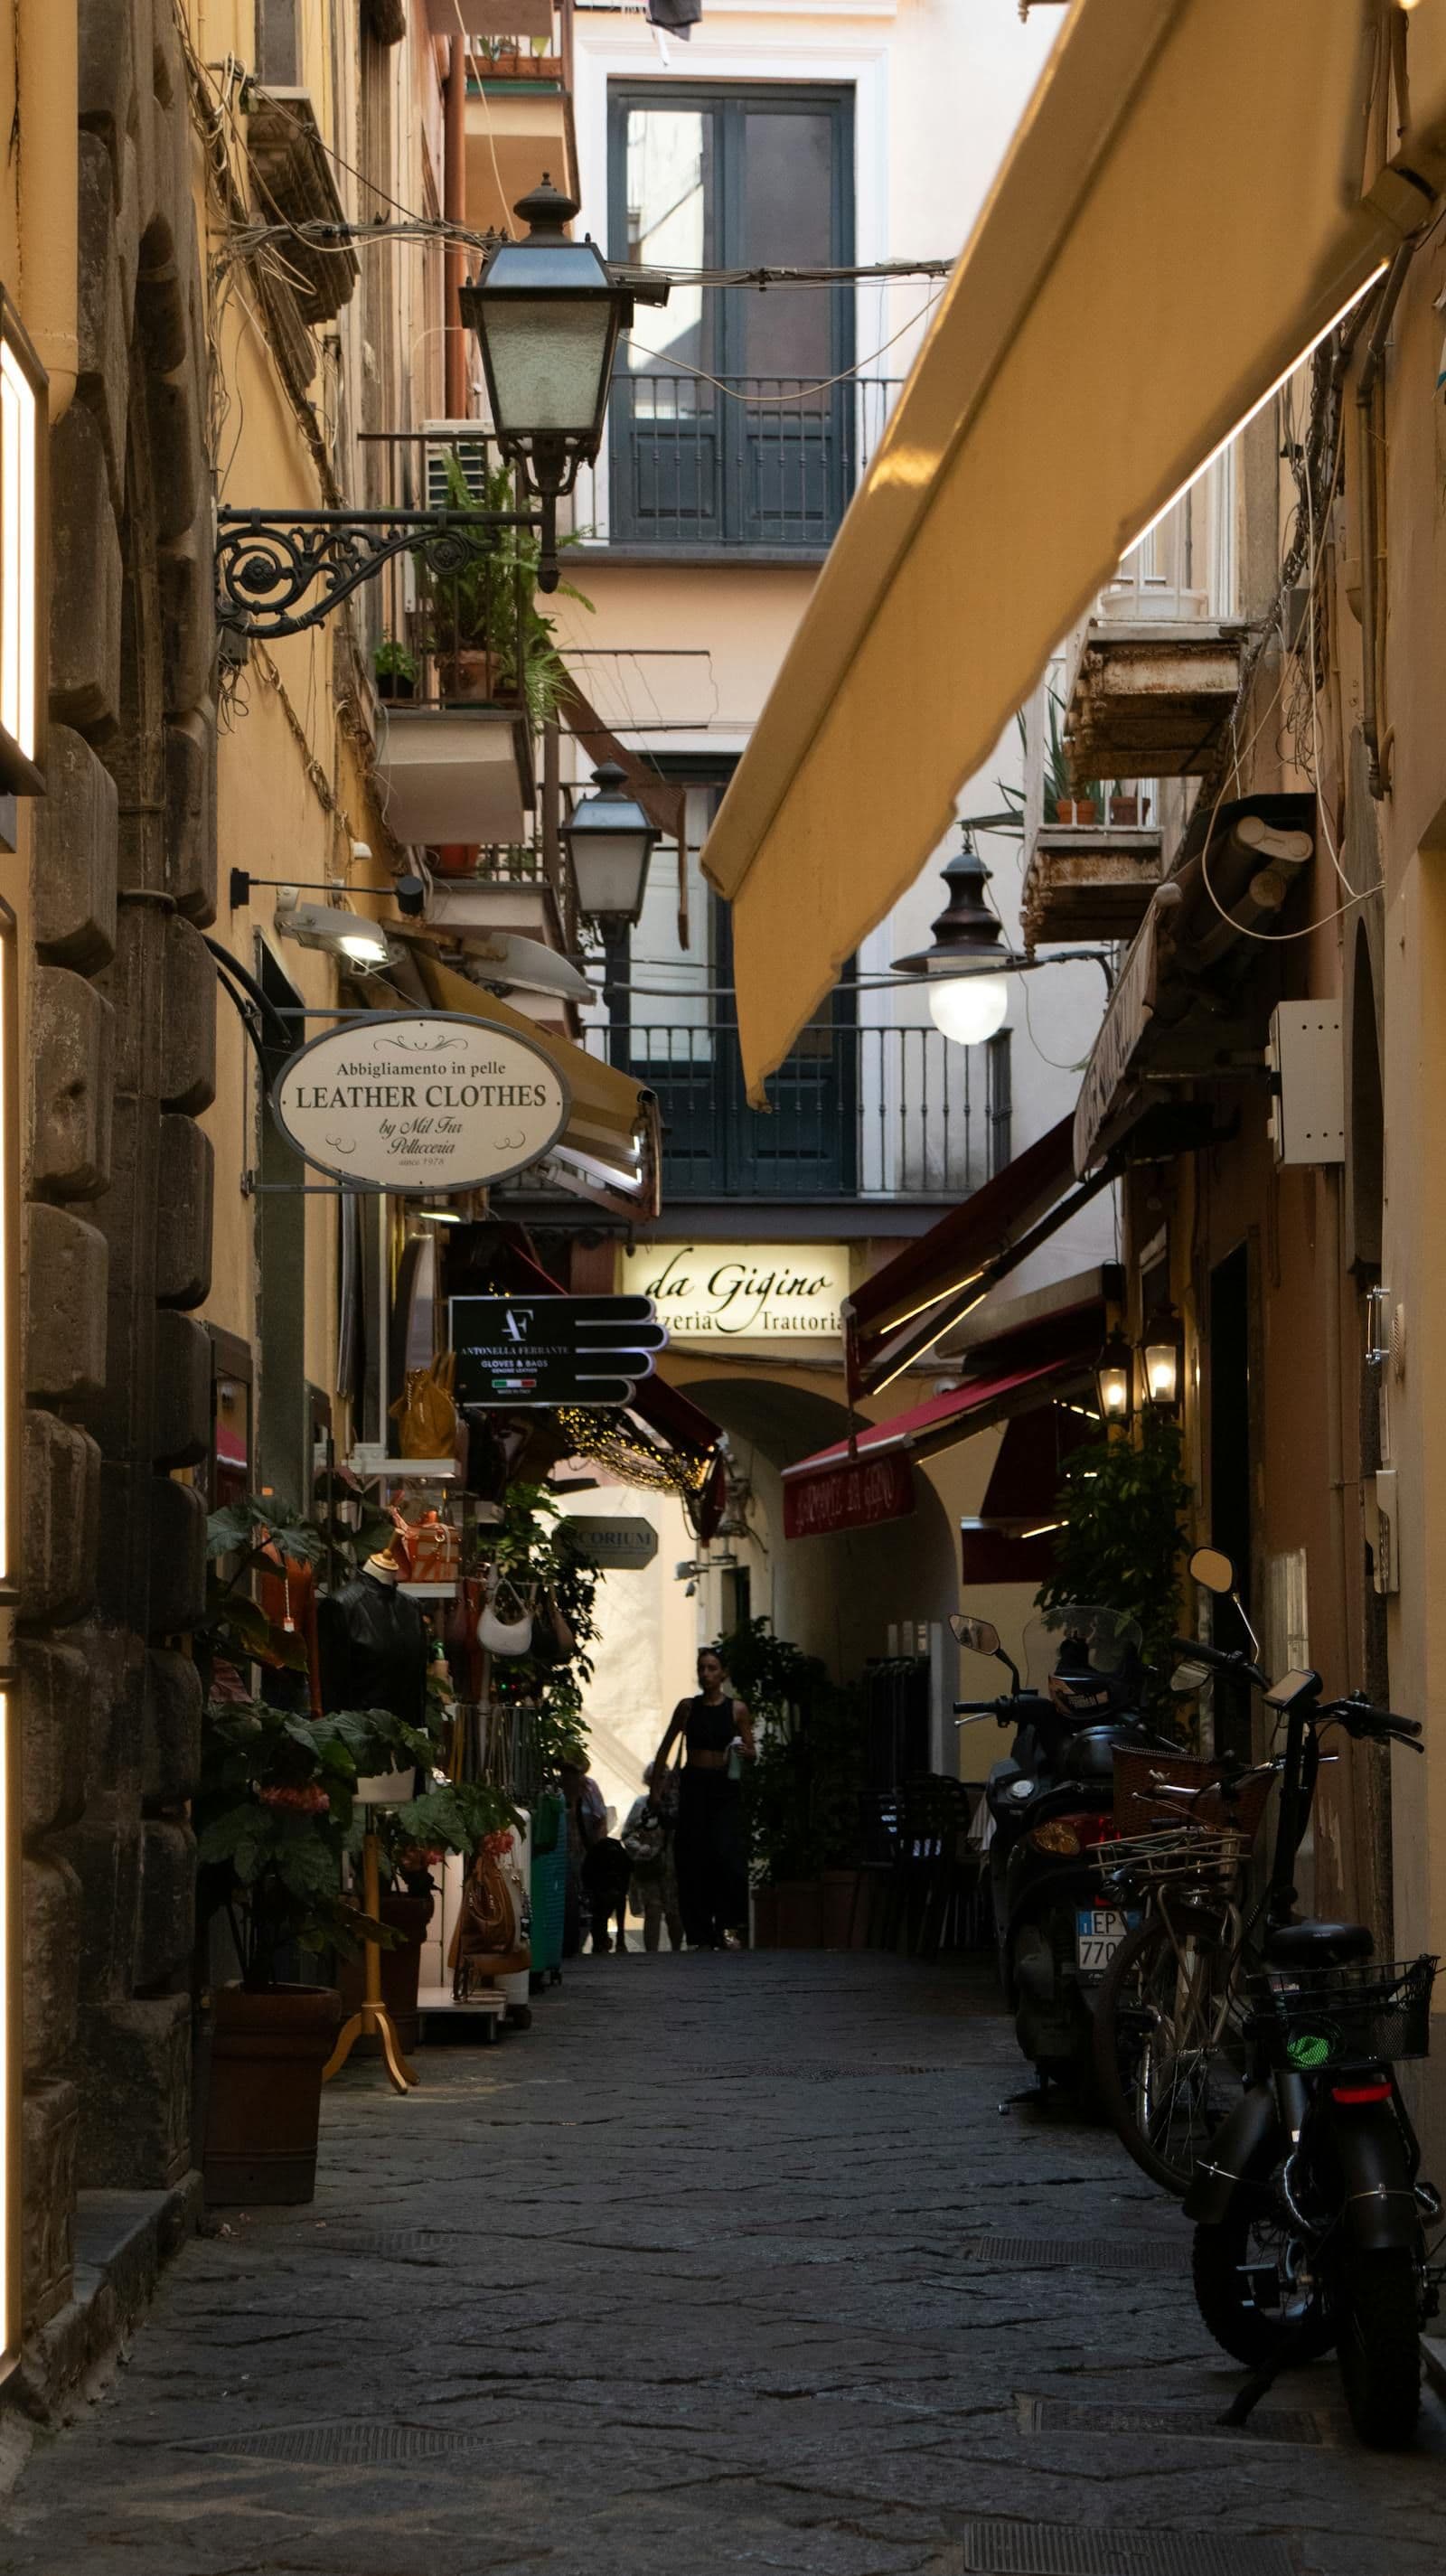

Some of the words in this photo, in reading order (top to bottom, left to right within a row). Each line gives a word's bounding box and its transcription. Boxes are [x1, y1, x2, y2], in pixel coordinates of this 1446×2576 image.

[336, 1061, 446, 1078] Abbigliamento
[452, 1062, 465, 1075] in
[471, 1061, 507, 1078] pelle
[296, 1086, 418, 1109] LEATHER
[425, 1085, 547, 1108] CLOTHES
[380, 1118, 397, 1140] by
[399, 1116, 434, 1134] Mil
[434, 1115, 463, 1134] Fur
[386, 1136, 455, 1154] Pellicceria
[398, 1158, 420, 1166] since
[645, 1246, 694, 1300] da
[707, 1264, 833, 1334] Gigino
[654, 1311, 712, 1330] zeria
[461, 1346, 517, 1356] ANTONELLA
[518, 1346, 571, 1355] FERRANTE
[481, 1359, 514, 1368] GLOVES
[525, 1359, 549, 1368] BAGS
[1094, 1913, 1116, 1934] EP
